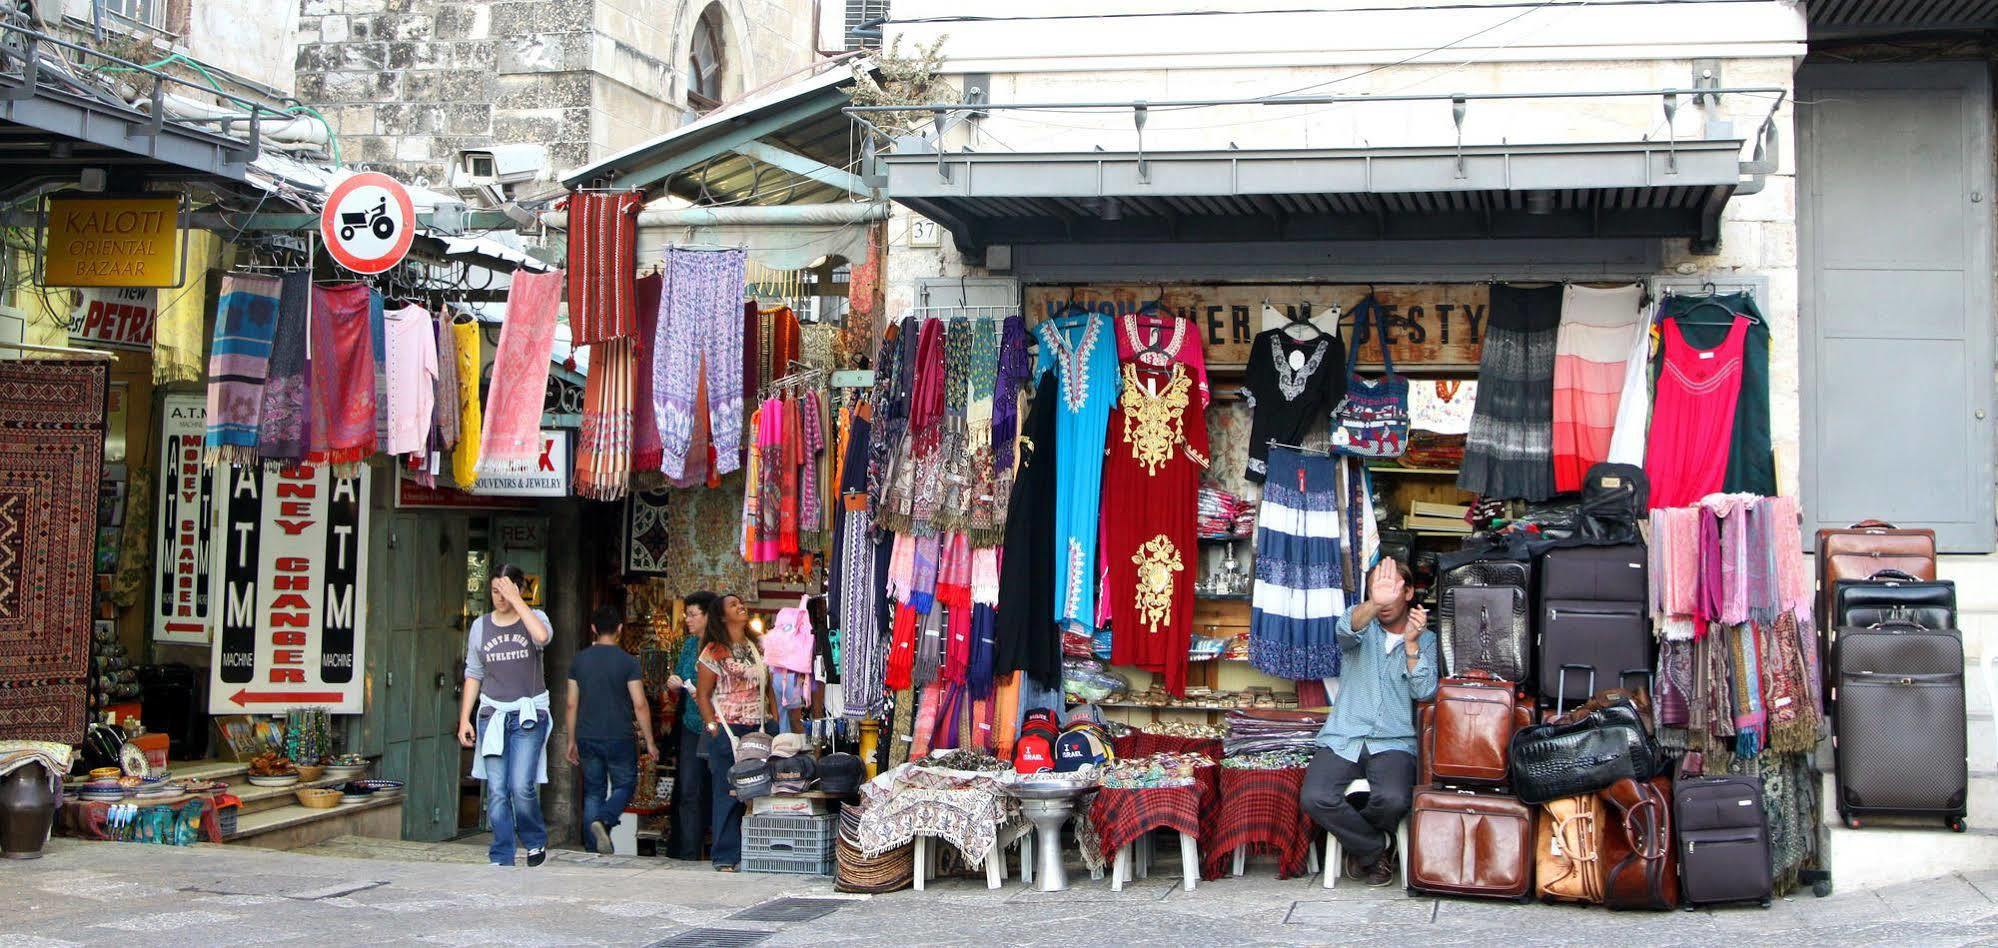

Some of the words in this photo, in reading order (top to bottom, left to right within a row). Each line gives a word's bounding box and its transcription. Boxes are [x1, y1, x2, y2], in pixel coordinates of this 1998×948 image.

[65, 210, 164, 234] KALOTI
[914, 222, 935, 238] 37
[69, 240, 155, 256] ORIENTAL
[76, 261, 145, 277] BAZAAR
[182, 435, 201, 503] MONEY
[475, 477, 517, 489] SOUVENIRS
[518, 478, 525, 489] &
[526, 477, 561, 489] JEWELRY
[163, 441, 178, 575] ATM
[274, 465, 317, 535] ONEY
[504, 526, 537, 540] REX
[227, 466, 258, 628] ATM
[326, 478, 355, 629] ATM
[178, 520, 195, 617] CHANGER
[269, 556, 311, 683] CHANGER
[484, 633, 510, 651] SOUTH
[512, 633, 528, 648] HIGH
[223, 652, 253, 667] MACHINE
[322, 653, 352, 668] MACHINE
[486, 649, 529, 663] ATHLETICS
[1025, 746, 1031, 754] I
[1062, 751, 1084, 759] ISRAEL
[1064, 744, 1069, 752] I
